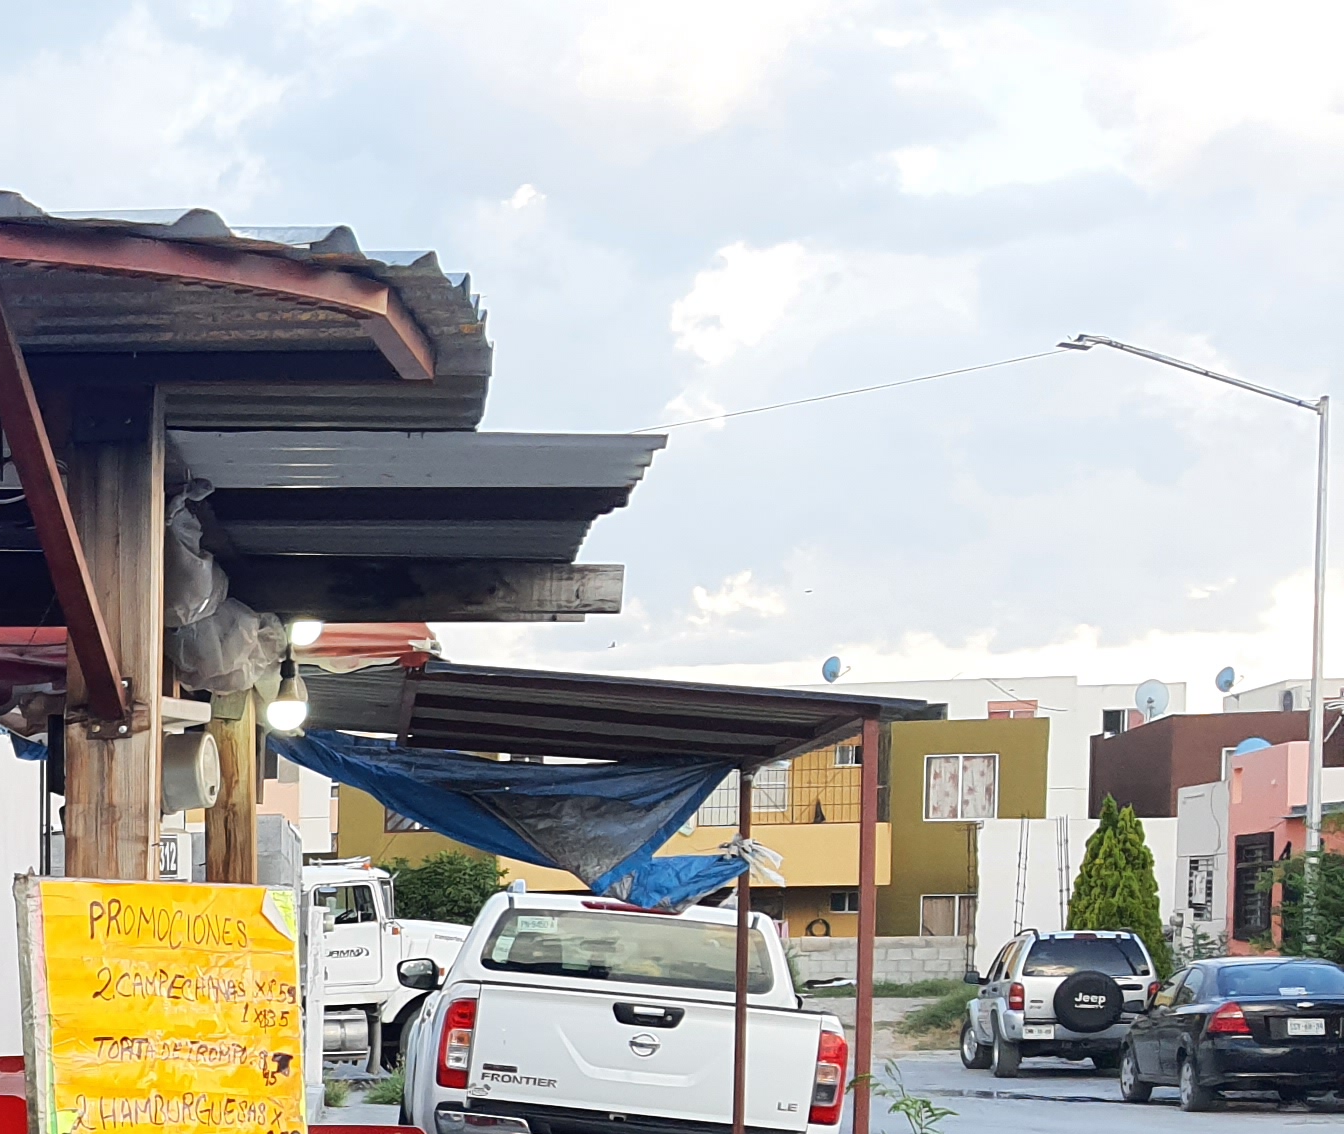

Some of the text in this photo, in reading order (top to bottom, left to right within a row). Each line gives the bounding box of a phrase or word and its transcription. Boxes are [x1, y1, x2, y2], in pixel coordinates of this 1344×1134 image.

[90, 898, 247, 949] PROMOCIONES
[1074, 992, 1106, 1005] Jeep
[481, 1072, 557, 1088] FRONTIER
[75, 1092, 266, 1131] 2 HAMBURGUESAS
[777, 1102, 798, 1112] LE
